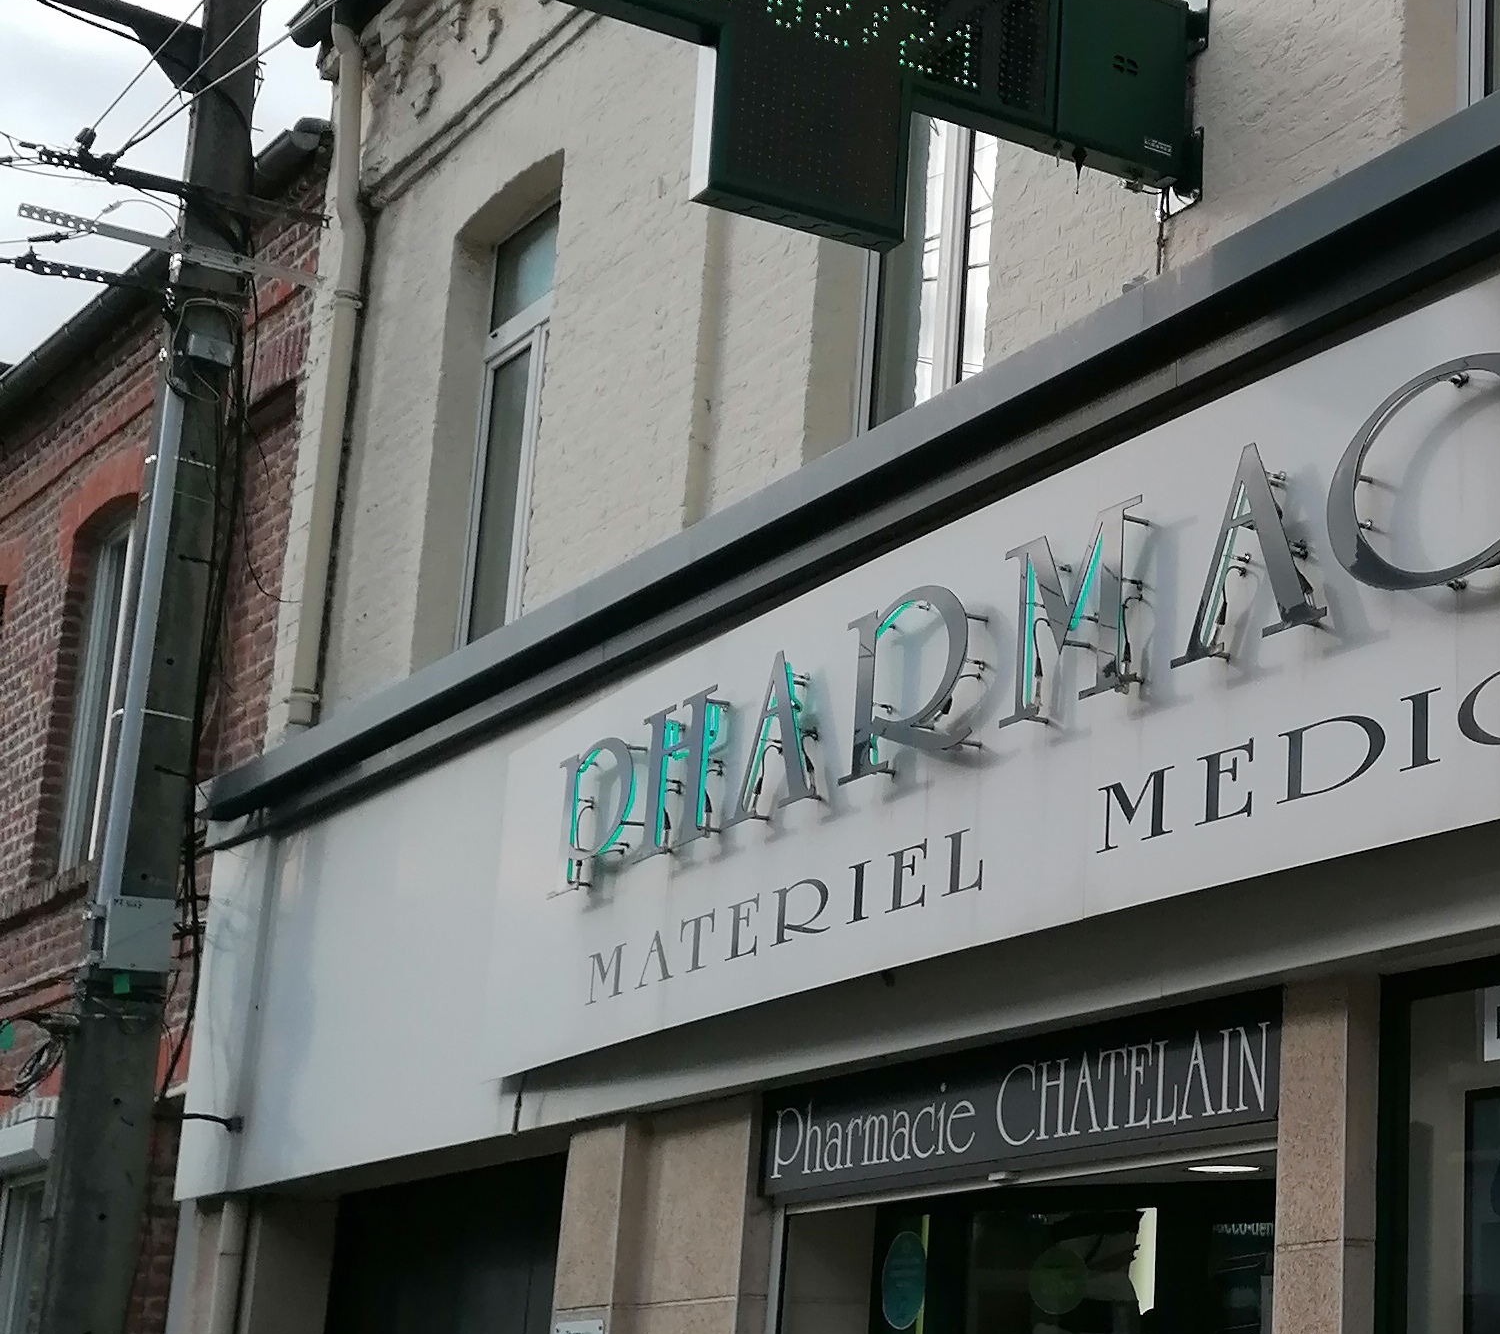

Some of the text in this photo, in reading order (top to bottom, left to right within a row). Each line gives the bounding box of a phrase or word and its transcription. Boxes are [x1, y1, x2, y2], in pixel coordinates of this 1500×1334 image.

[585, 828, 984, 1006] MATERIEL
[770, 1021, 1271, 1180] Pharmacie CHATELAIN
